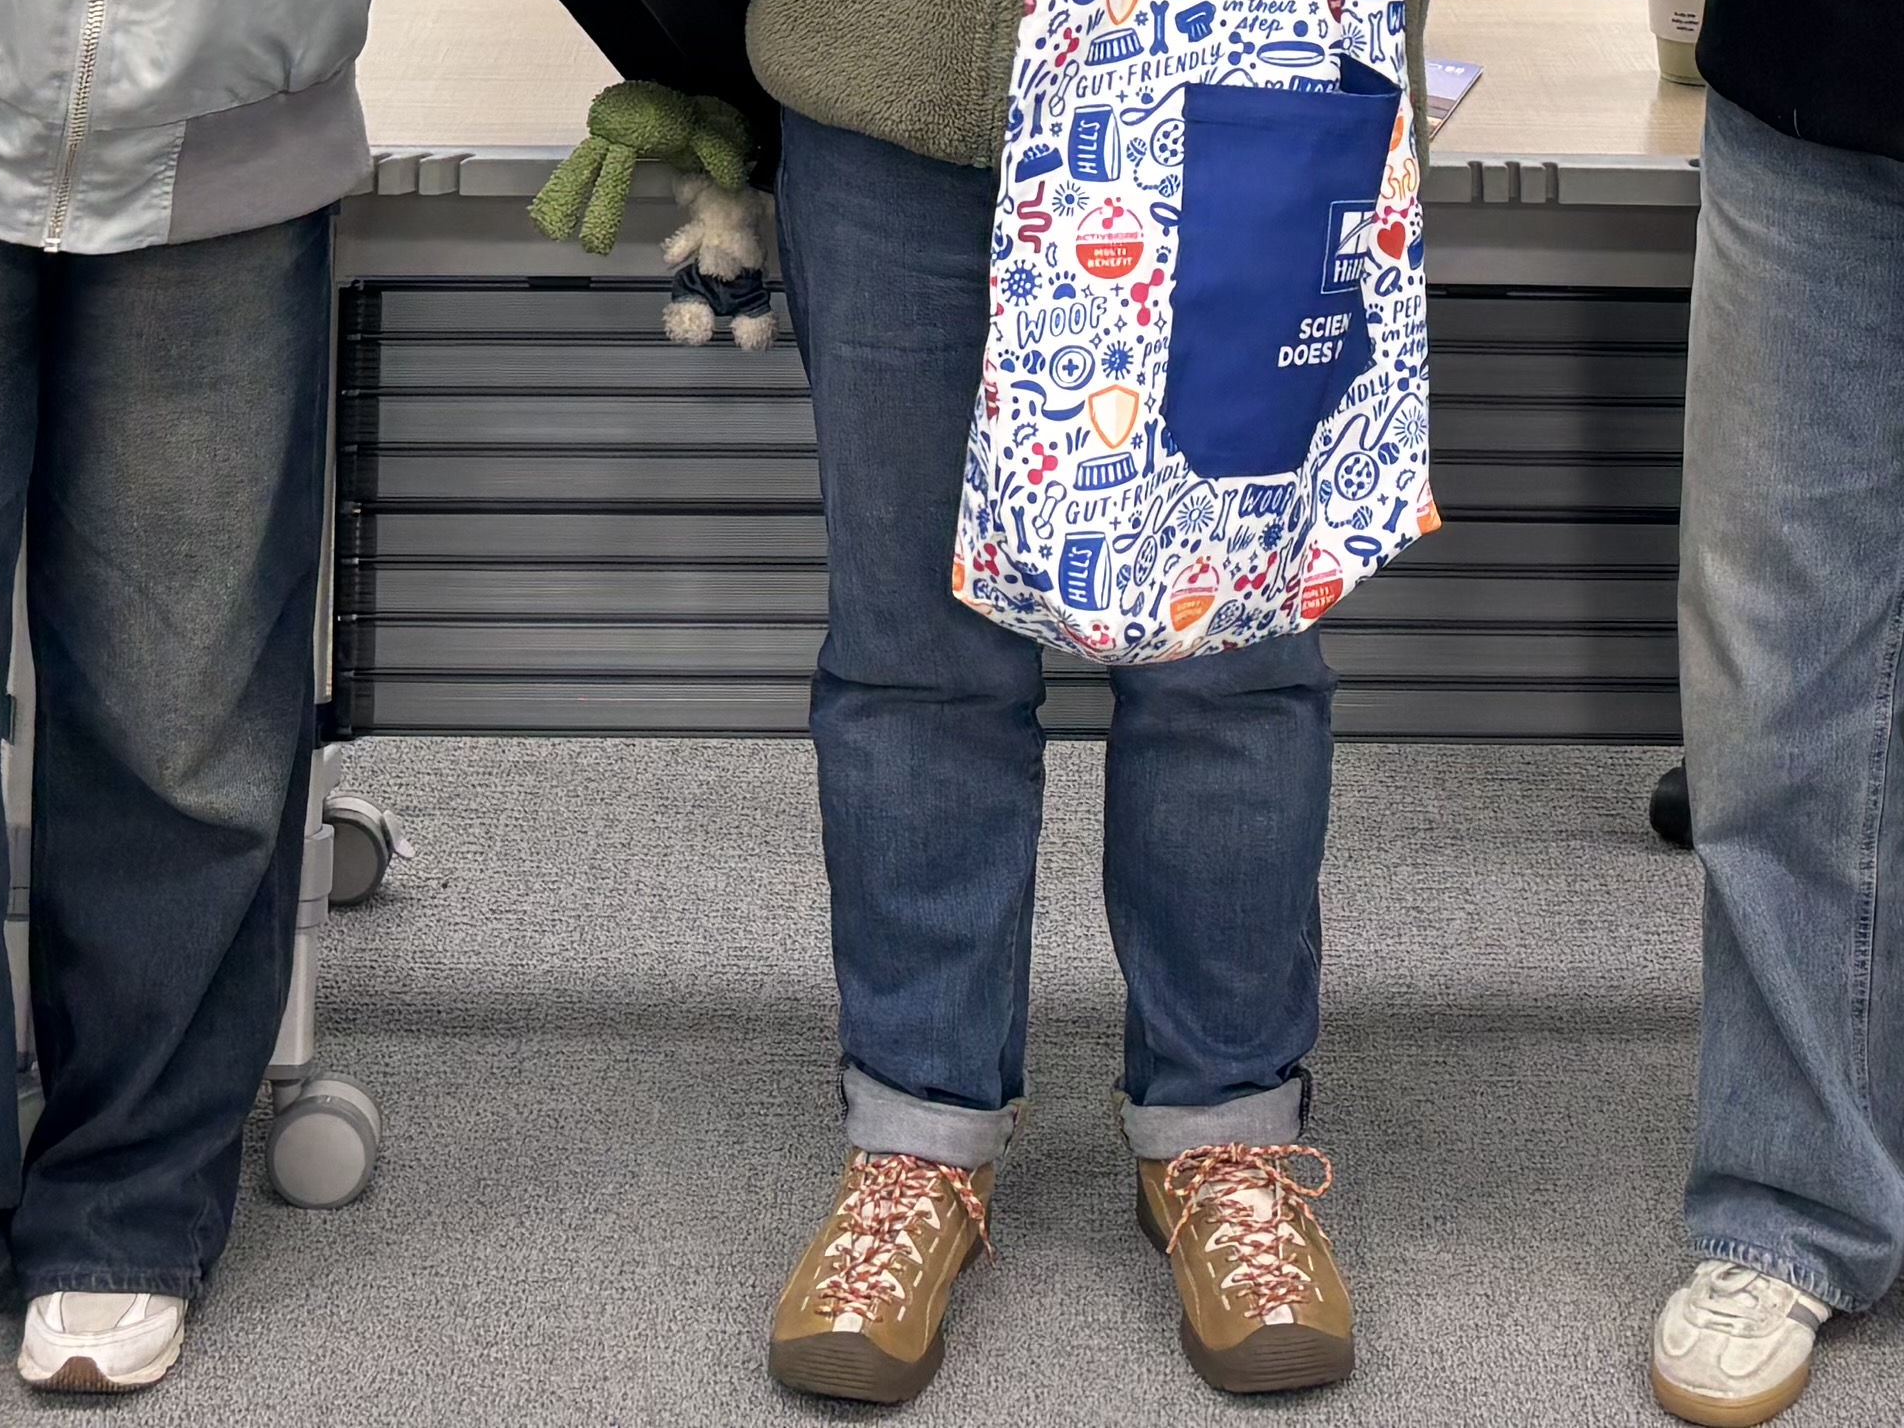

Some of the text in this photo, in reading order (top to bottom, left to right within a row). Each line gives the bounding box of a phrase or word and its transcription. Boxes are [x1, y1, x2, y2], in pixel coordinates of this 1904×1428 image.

[1234, 15, 1284, 40] step
[1076, 119, 1101, 175] HILL'S
[1016, 296, 1108, 350] WOOF
[1392, 294, 1422, 324] PEP
[1067, 546, 1093, 603] HILL'S
